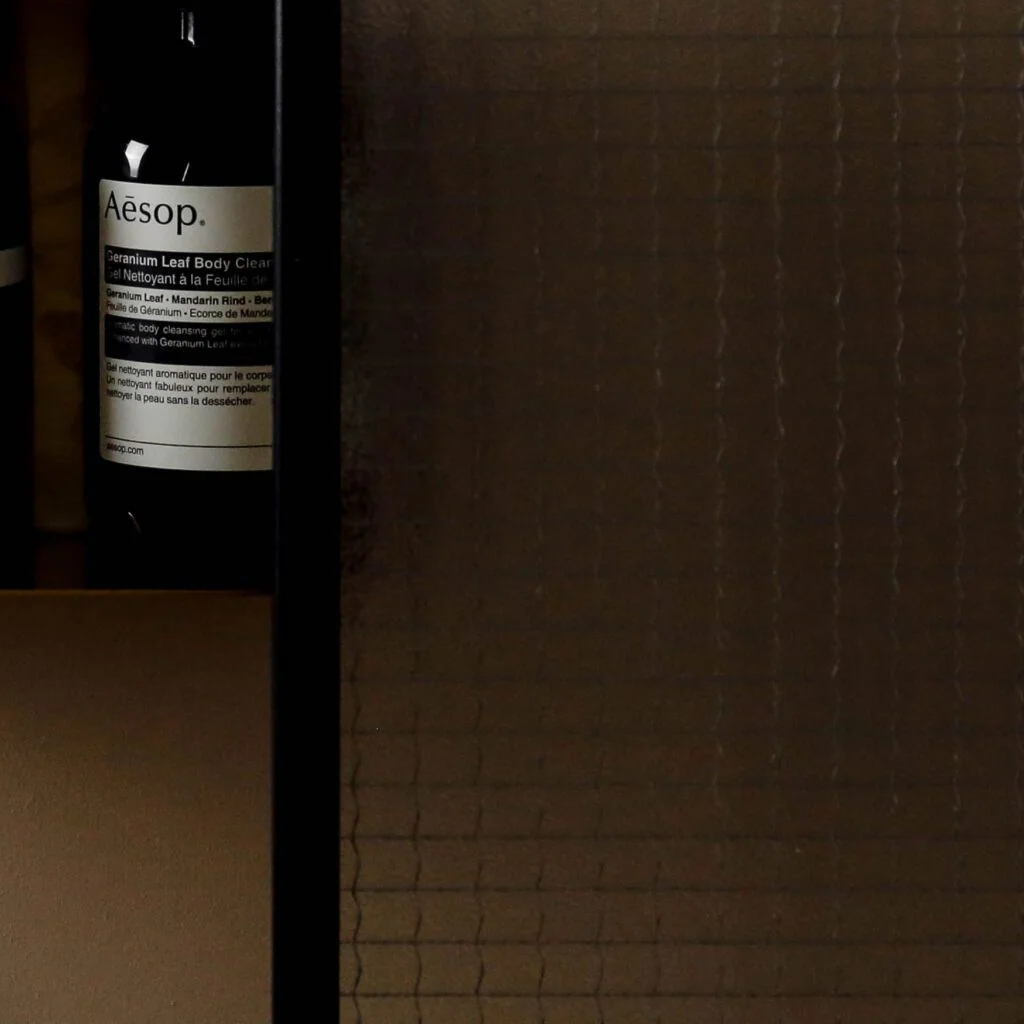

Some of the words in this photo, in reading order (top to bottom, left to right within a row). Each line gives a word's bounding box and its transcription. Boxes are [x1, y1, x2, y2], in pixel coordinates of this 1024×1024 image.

[106, 249, 158, 267] Geranium
[161, 255, 190, 269] Leaf
[194, 256, 231, 273] Body
[123, 267, 177, 286] Nettoyant
[179, 272, 187, 286] à
[190, 273, 202, 286] la
[206, 273, 248, 286] Feuille
[251, 274, 268, 286] de
[106, 288, 143, 301] Geranium
[144, 292, 164, 303] Leaf
[171, 294, 219, 305] Mandarin
[222, 296, 246, 305] Rind
[128, 304, 138, 314] de
[139, 304, 182, 317] Géranium
[189, 308, 223, 318] Ecorce
[225, 309, 239, 318] de
[138, 323, 160, 336] body
[162, 325, 207, 338] cleansing
[140, 336, 158, 347] with
[159, 337, 205, 349] Geranium
[119, 365, 154, 378] nettoyant
[155, 370, 207, 382] aromatique
[209, 372, 232, 382] pour
[234, 370, 244, 381] le
[118, 378, 152, 390] nettoyant
[154, 381, 194, 392] fabuleux
[196, 385, 219, 394] pour
[222, 384, 271, 396] remplacer
[134, 391, 142, 401] la
[143, 394, 164, 404] peau
[166, 396, 189, 406] sans
[190, 396, 199, 406] la
